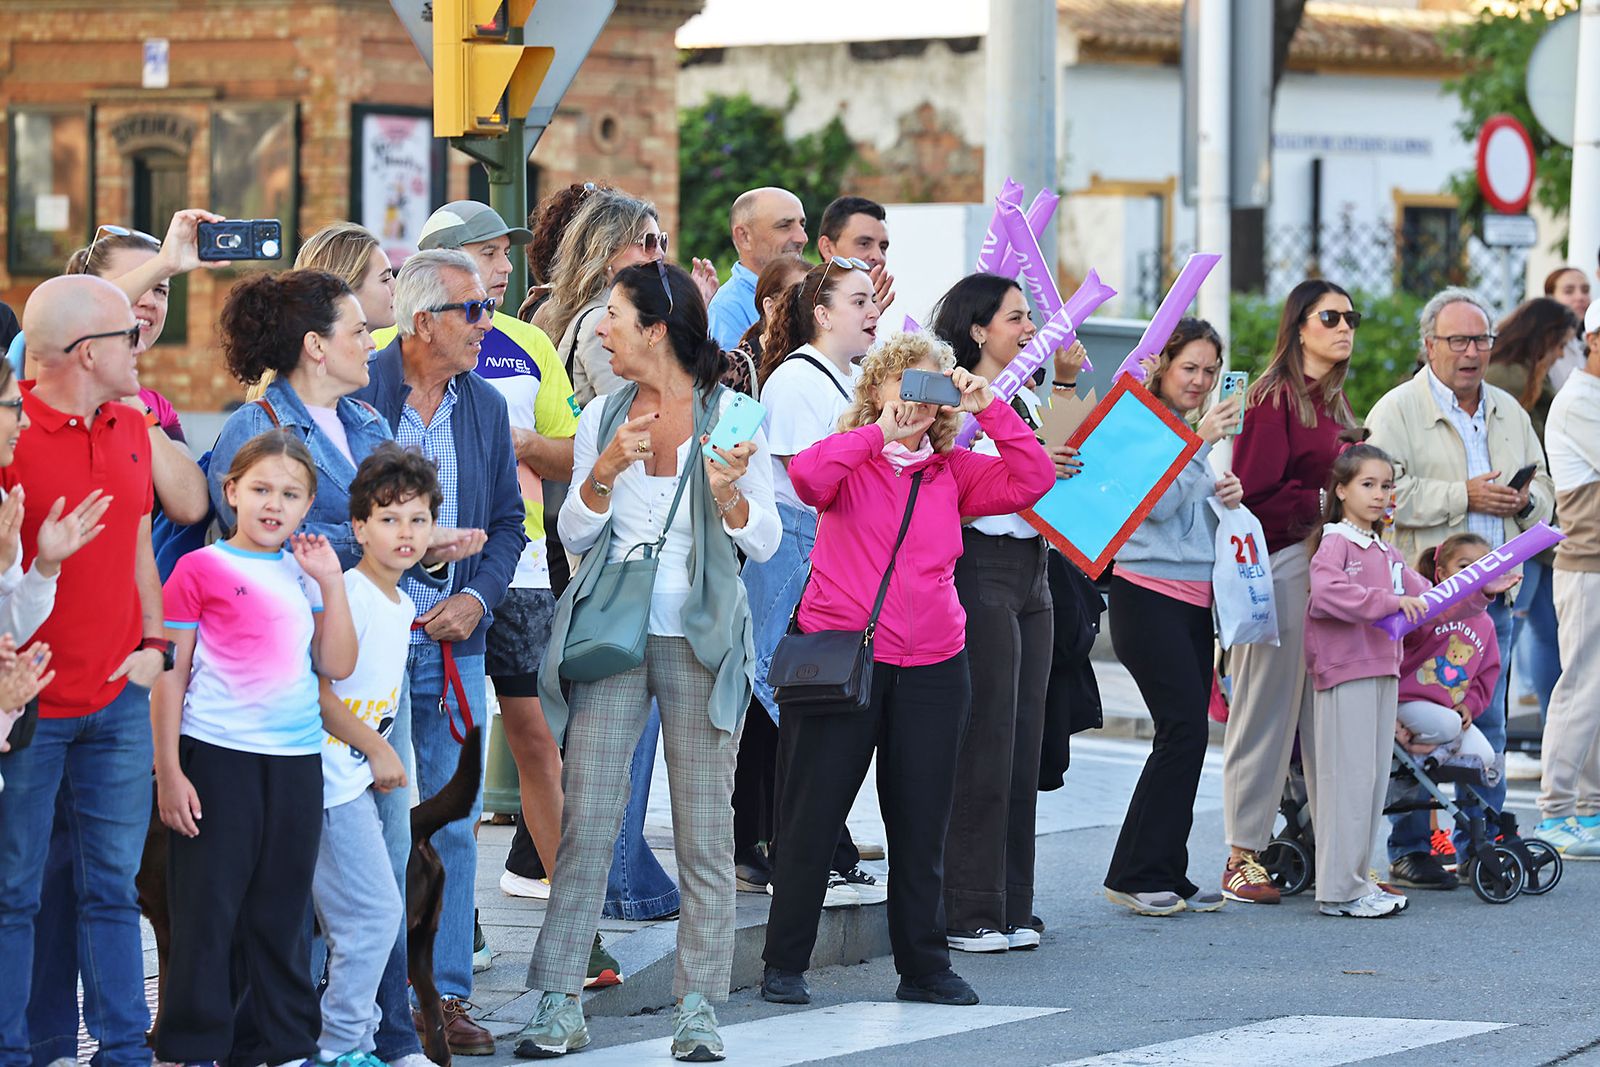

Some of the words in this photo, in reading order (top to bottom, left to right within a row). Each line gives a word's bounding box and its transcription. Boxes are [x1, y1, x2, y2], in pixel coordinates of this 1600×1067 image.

[485, 356, 531, 370] AVATEL
[1230, 532, 1260, 565] 21
[1419, 550, 1514, 612] AVATEL
[1434, 621, 1485, 657] CALIORNI
